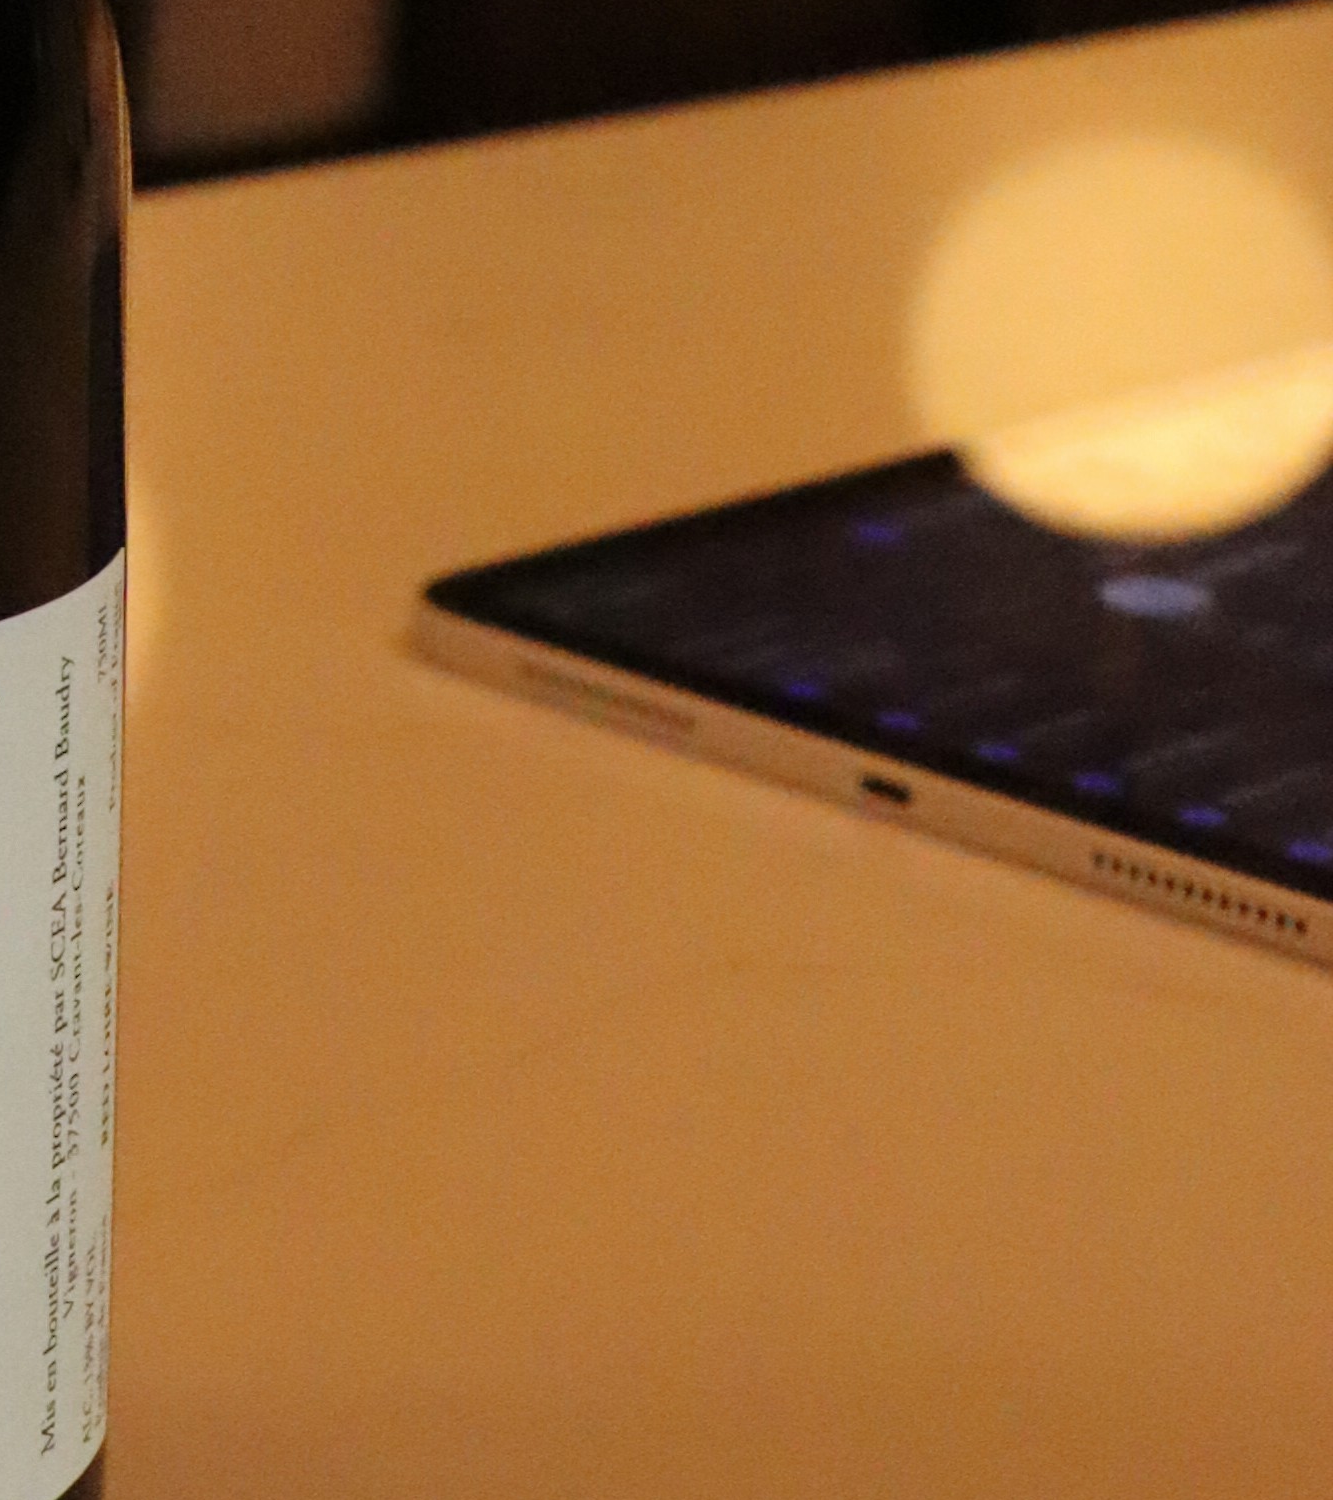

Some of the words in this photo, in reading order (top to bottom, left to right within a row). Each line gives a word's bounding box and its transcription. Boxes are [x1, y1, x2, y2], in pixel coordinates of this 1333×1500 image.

[54, 655, 76, 760] Baudry
[52, 769, 70, 885] Bernard
[50, 892, 68, 982] SCEA
[54, 989, 68, 1034] par
[49, 1042, 68, 1169] propriété
[45, 1178, 61, 1205] la
[46, 1207, 61, 1227] à
[43, 1232, 61, 1356] bouteille
[63, 1189, 79, 1320] Vigneron
[46, 1360, 58, 1393] en
[41, 1399, 57, 1456] Mis
